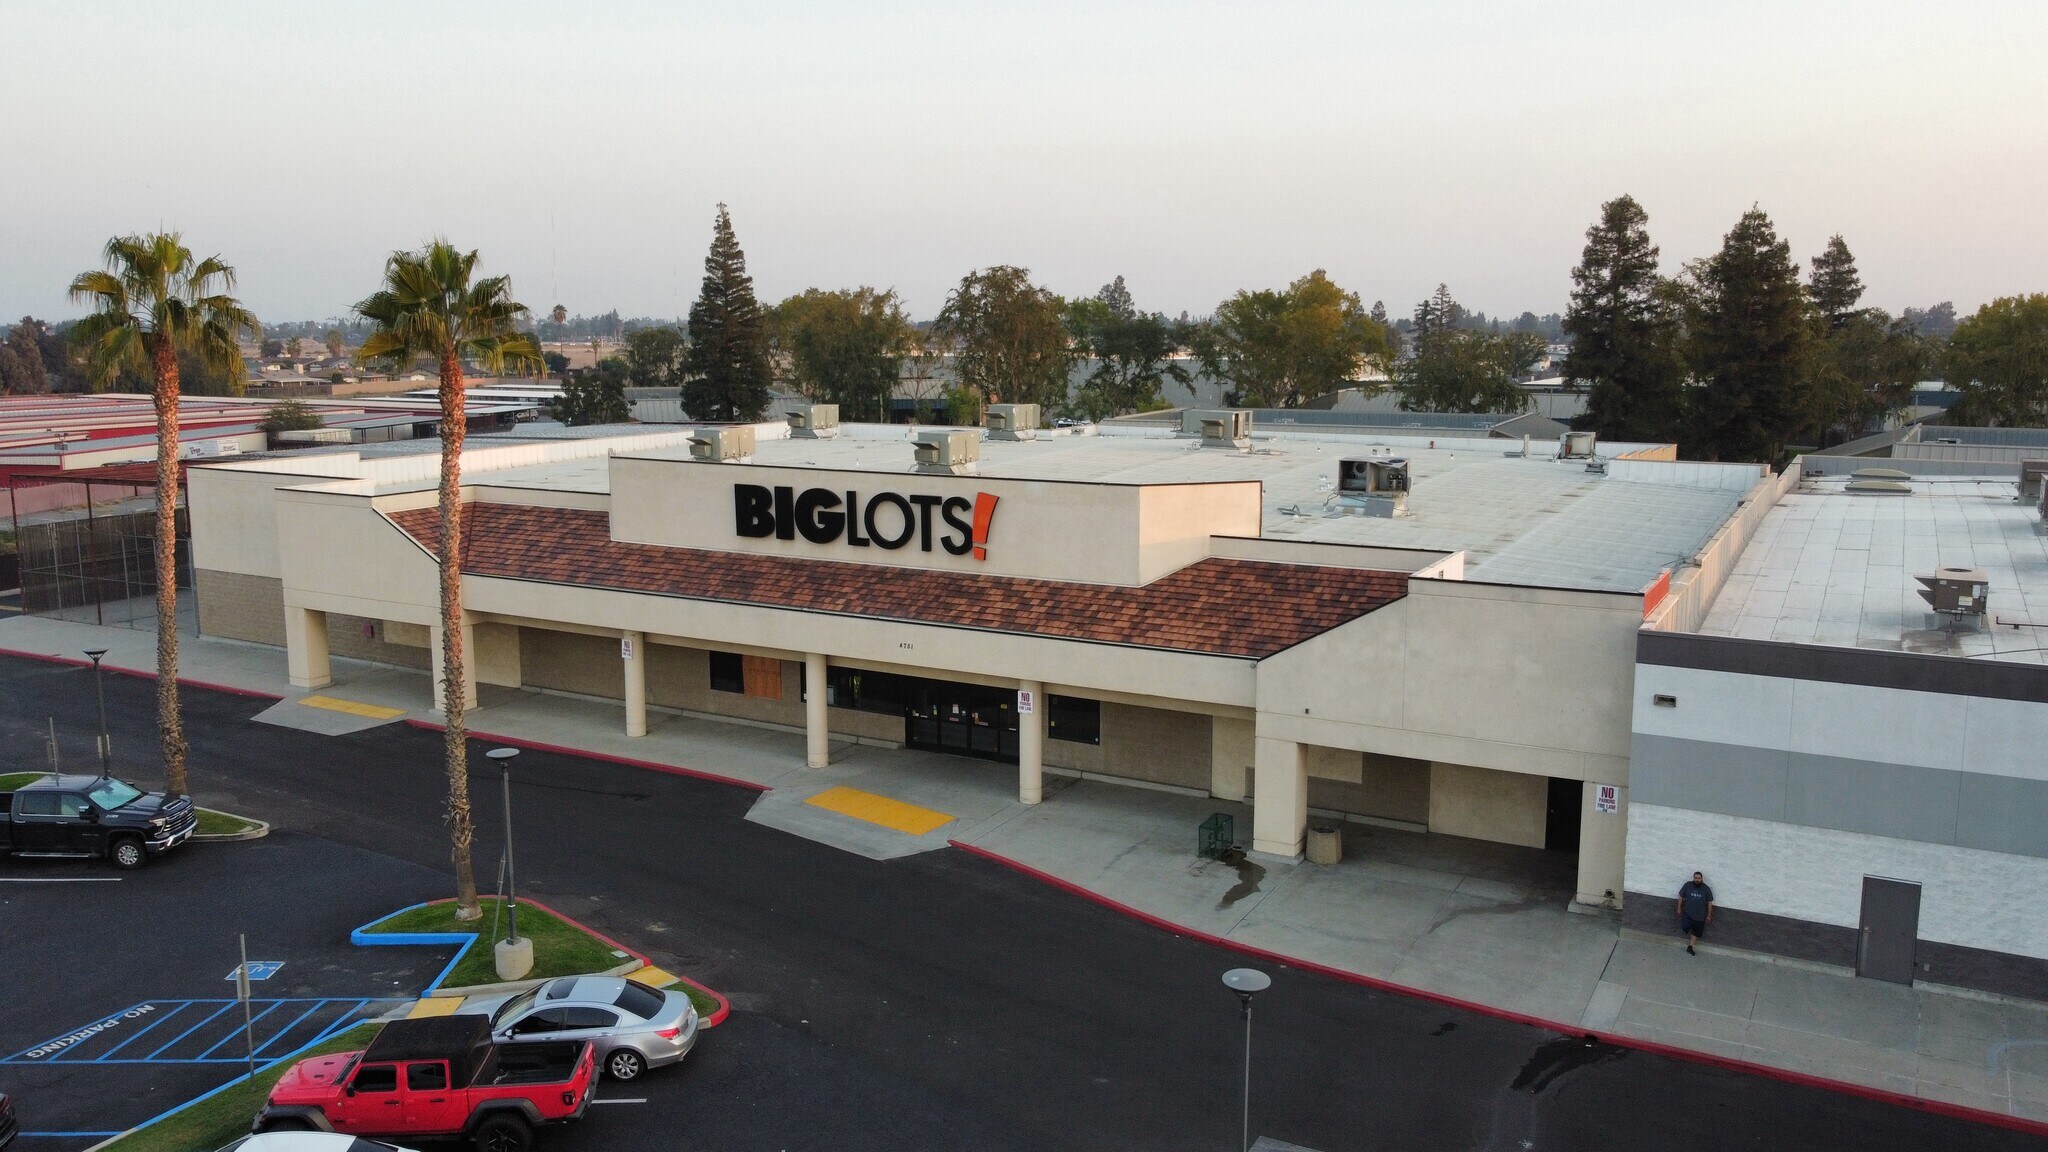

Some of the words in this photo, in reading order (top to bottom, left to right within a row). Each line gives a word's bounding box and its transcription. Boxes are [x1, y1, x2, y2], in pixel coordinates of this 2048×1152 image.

[1021, 692, 1030, 702] NO
[1601, 787, 1614, 799] NO
[124, 1004, 156, 1019] NO
[26, 1019, 120, 1059] PARKING
